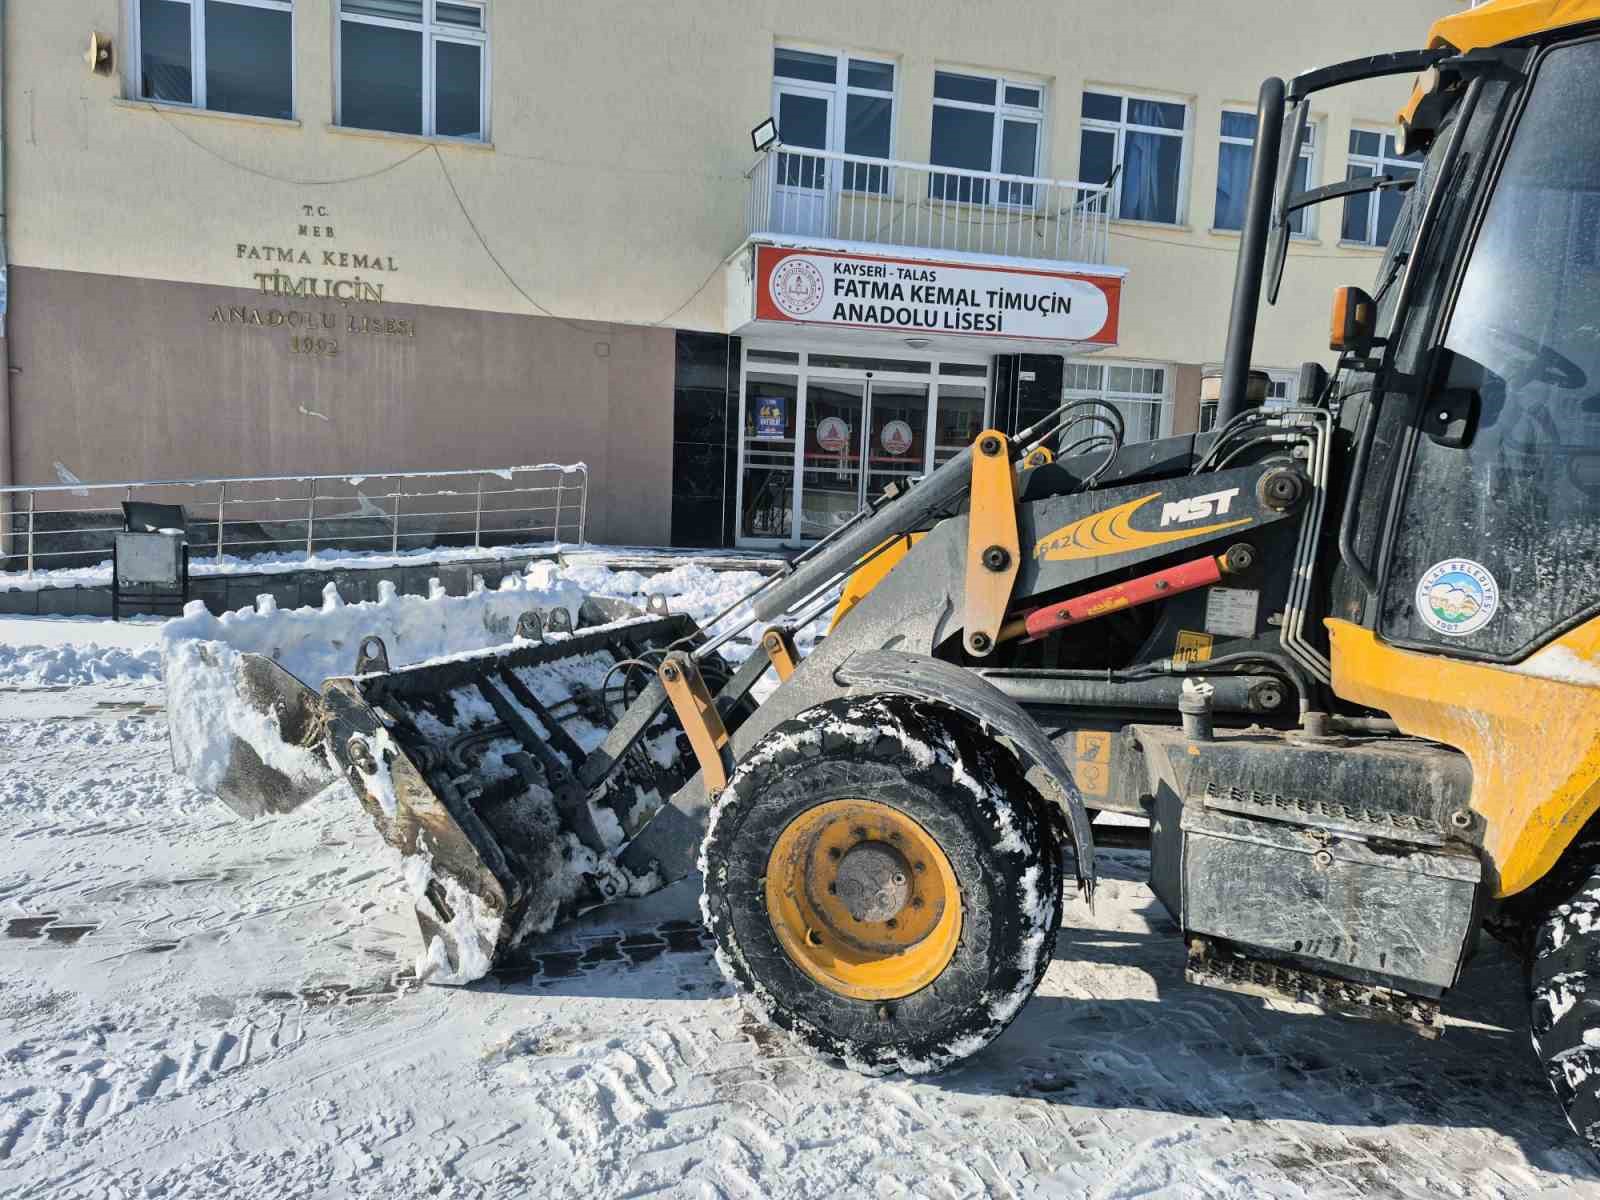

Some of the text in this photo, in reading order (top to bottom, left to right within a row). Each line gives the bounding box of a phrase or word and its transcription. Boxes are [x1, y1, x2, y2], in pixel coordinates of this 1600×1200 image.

[236, 243, 399, 271] FATMA KEMAL
[833, 261, 886, 278] KAYSERİ
[896, 267, 937, 282] TALAS
[253, 268, 384, 309] TİMUÇİN
[833, 278, 907, 302] FATMA
[910, 284, 981, 308] KEMAL
[986, 287, 1072, 317] TİMUÇİN
[209, 305, 337, 330] ANADOLU
[832, 302, 1003, 332] ANADOLU LİSESİ
[1160, 487, 1240, 527] MST
